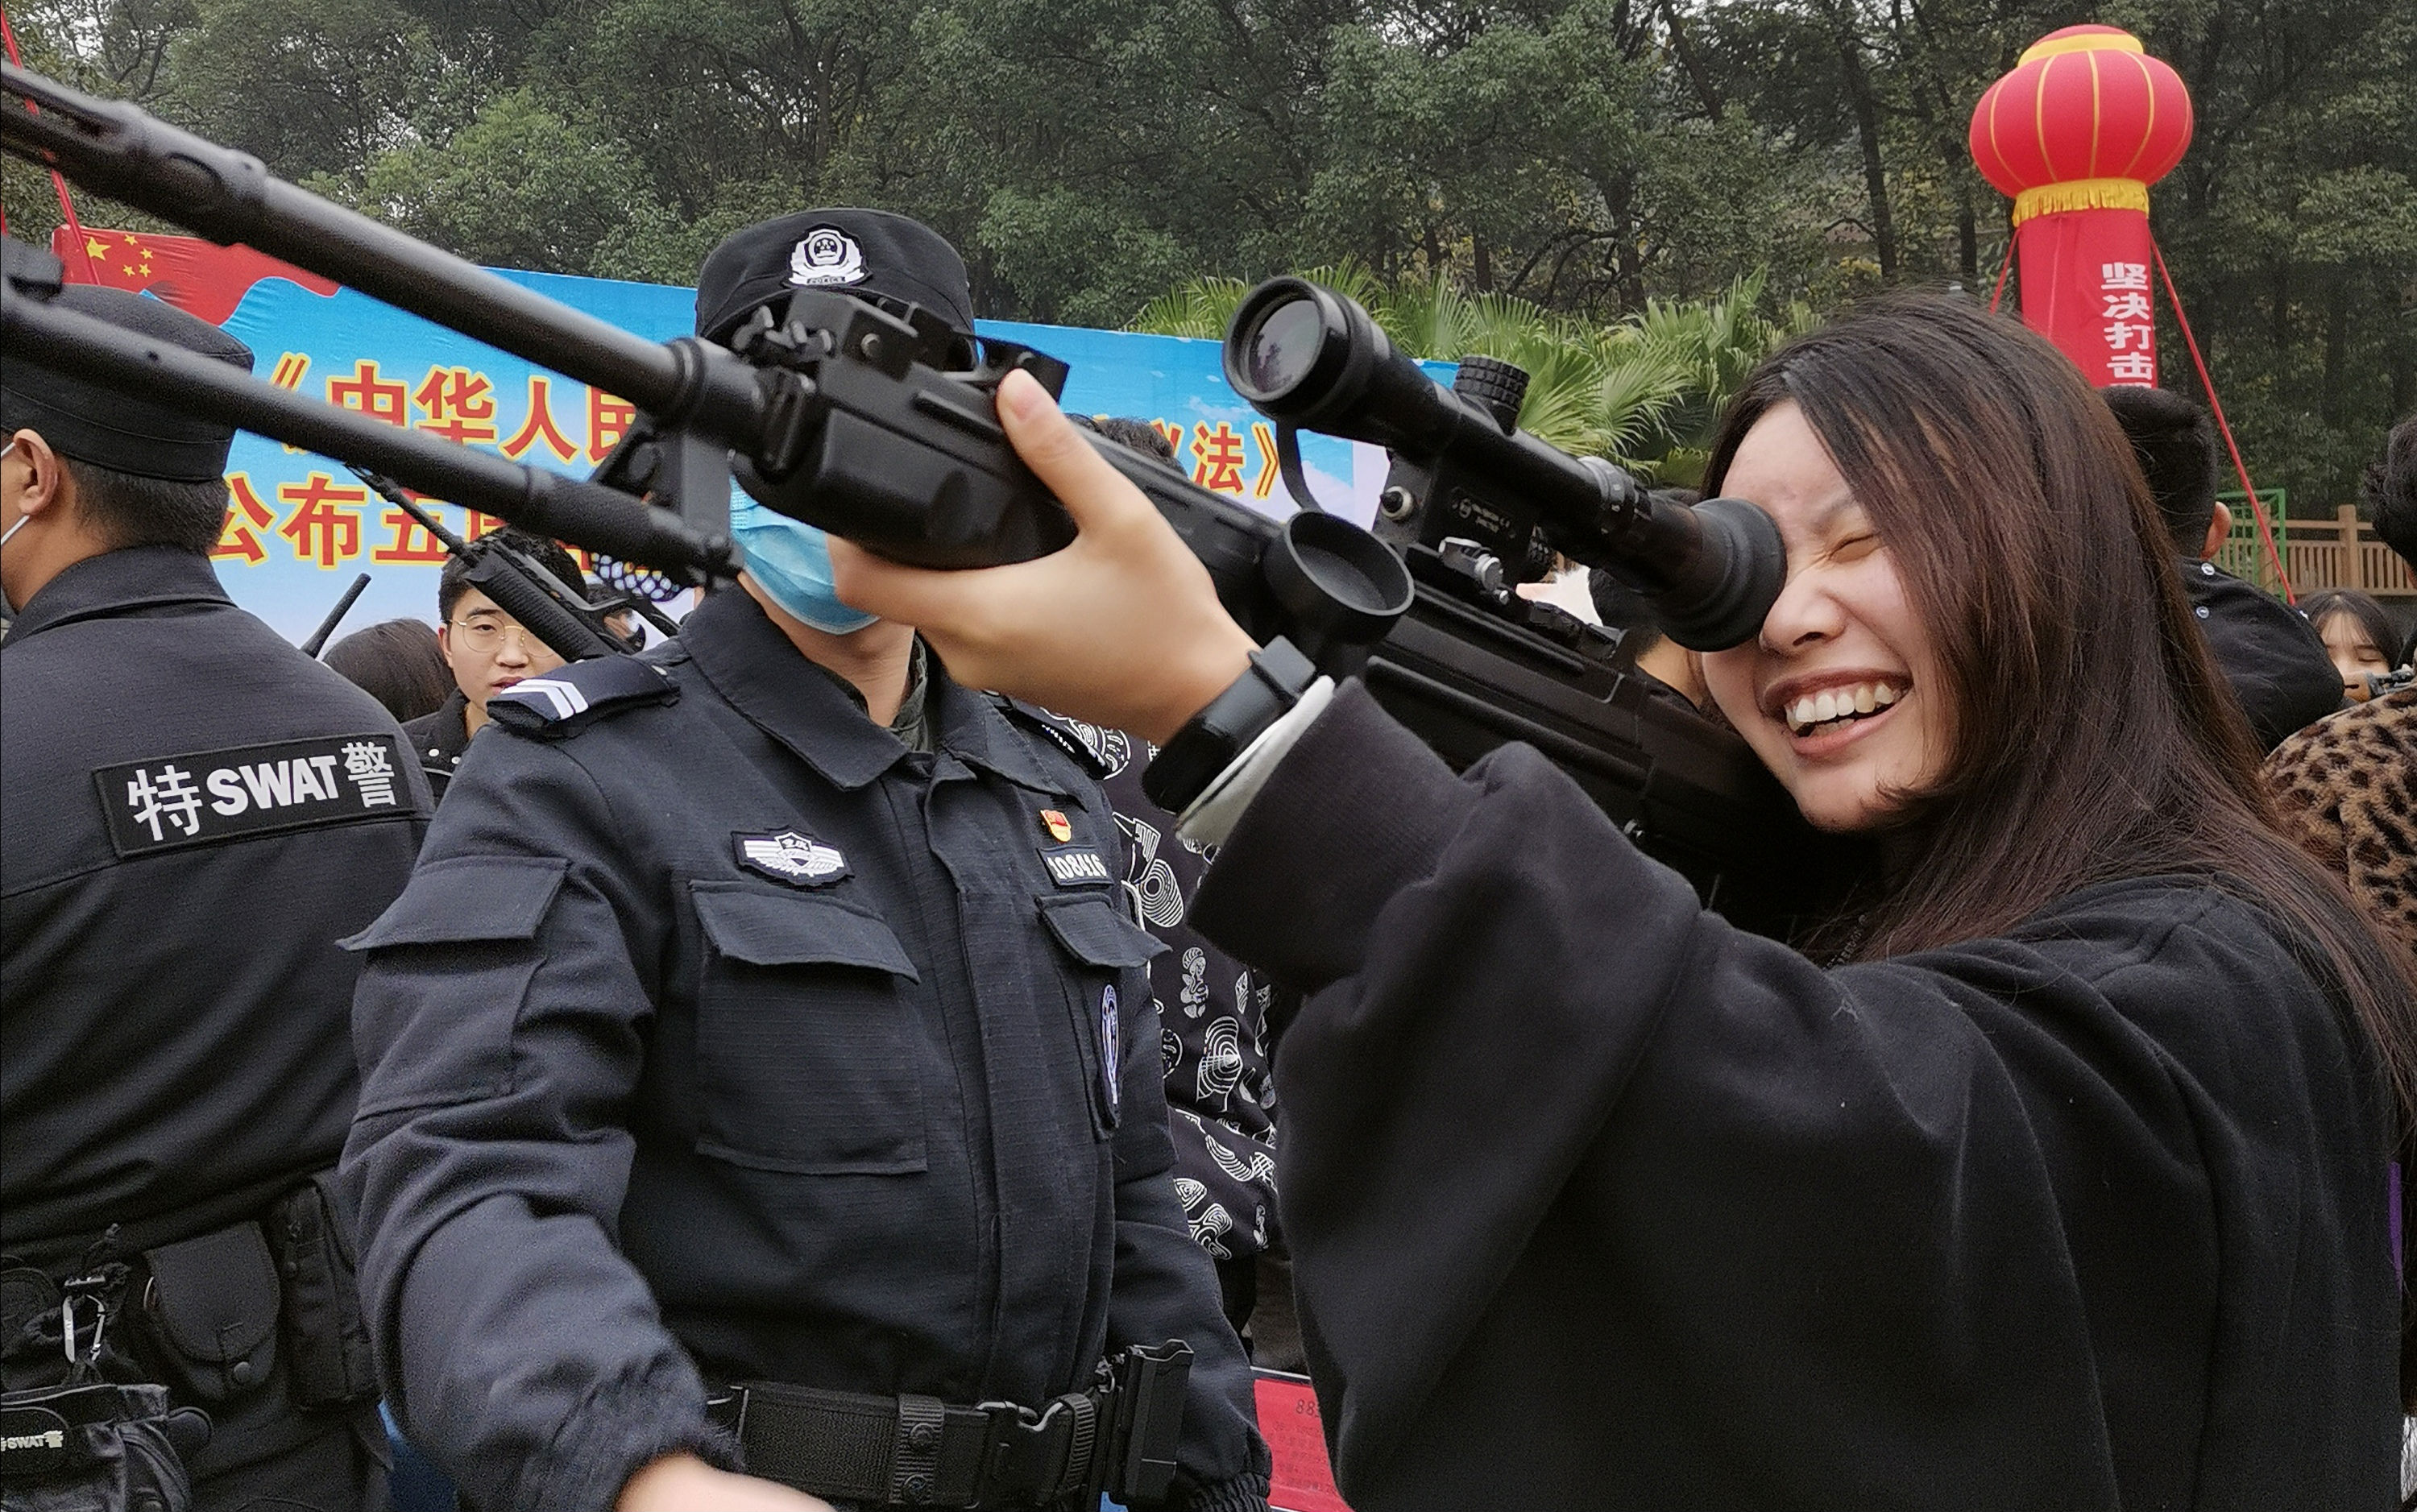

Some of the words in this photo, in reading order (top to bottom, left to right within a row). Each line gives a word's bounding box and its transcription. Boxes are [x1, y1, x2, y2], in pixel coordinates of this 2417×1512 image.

[2101, 262, 2153, 388] 坚决打击
[211, 473, 516, 567] 公布五
